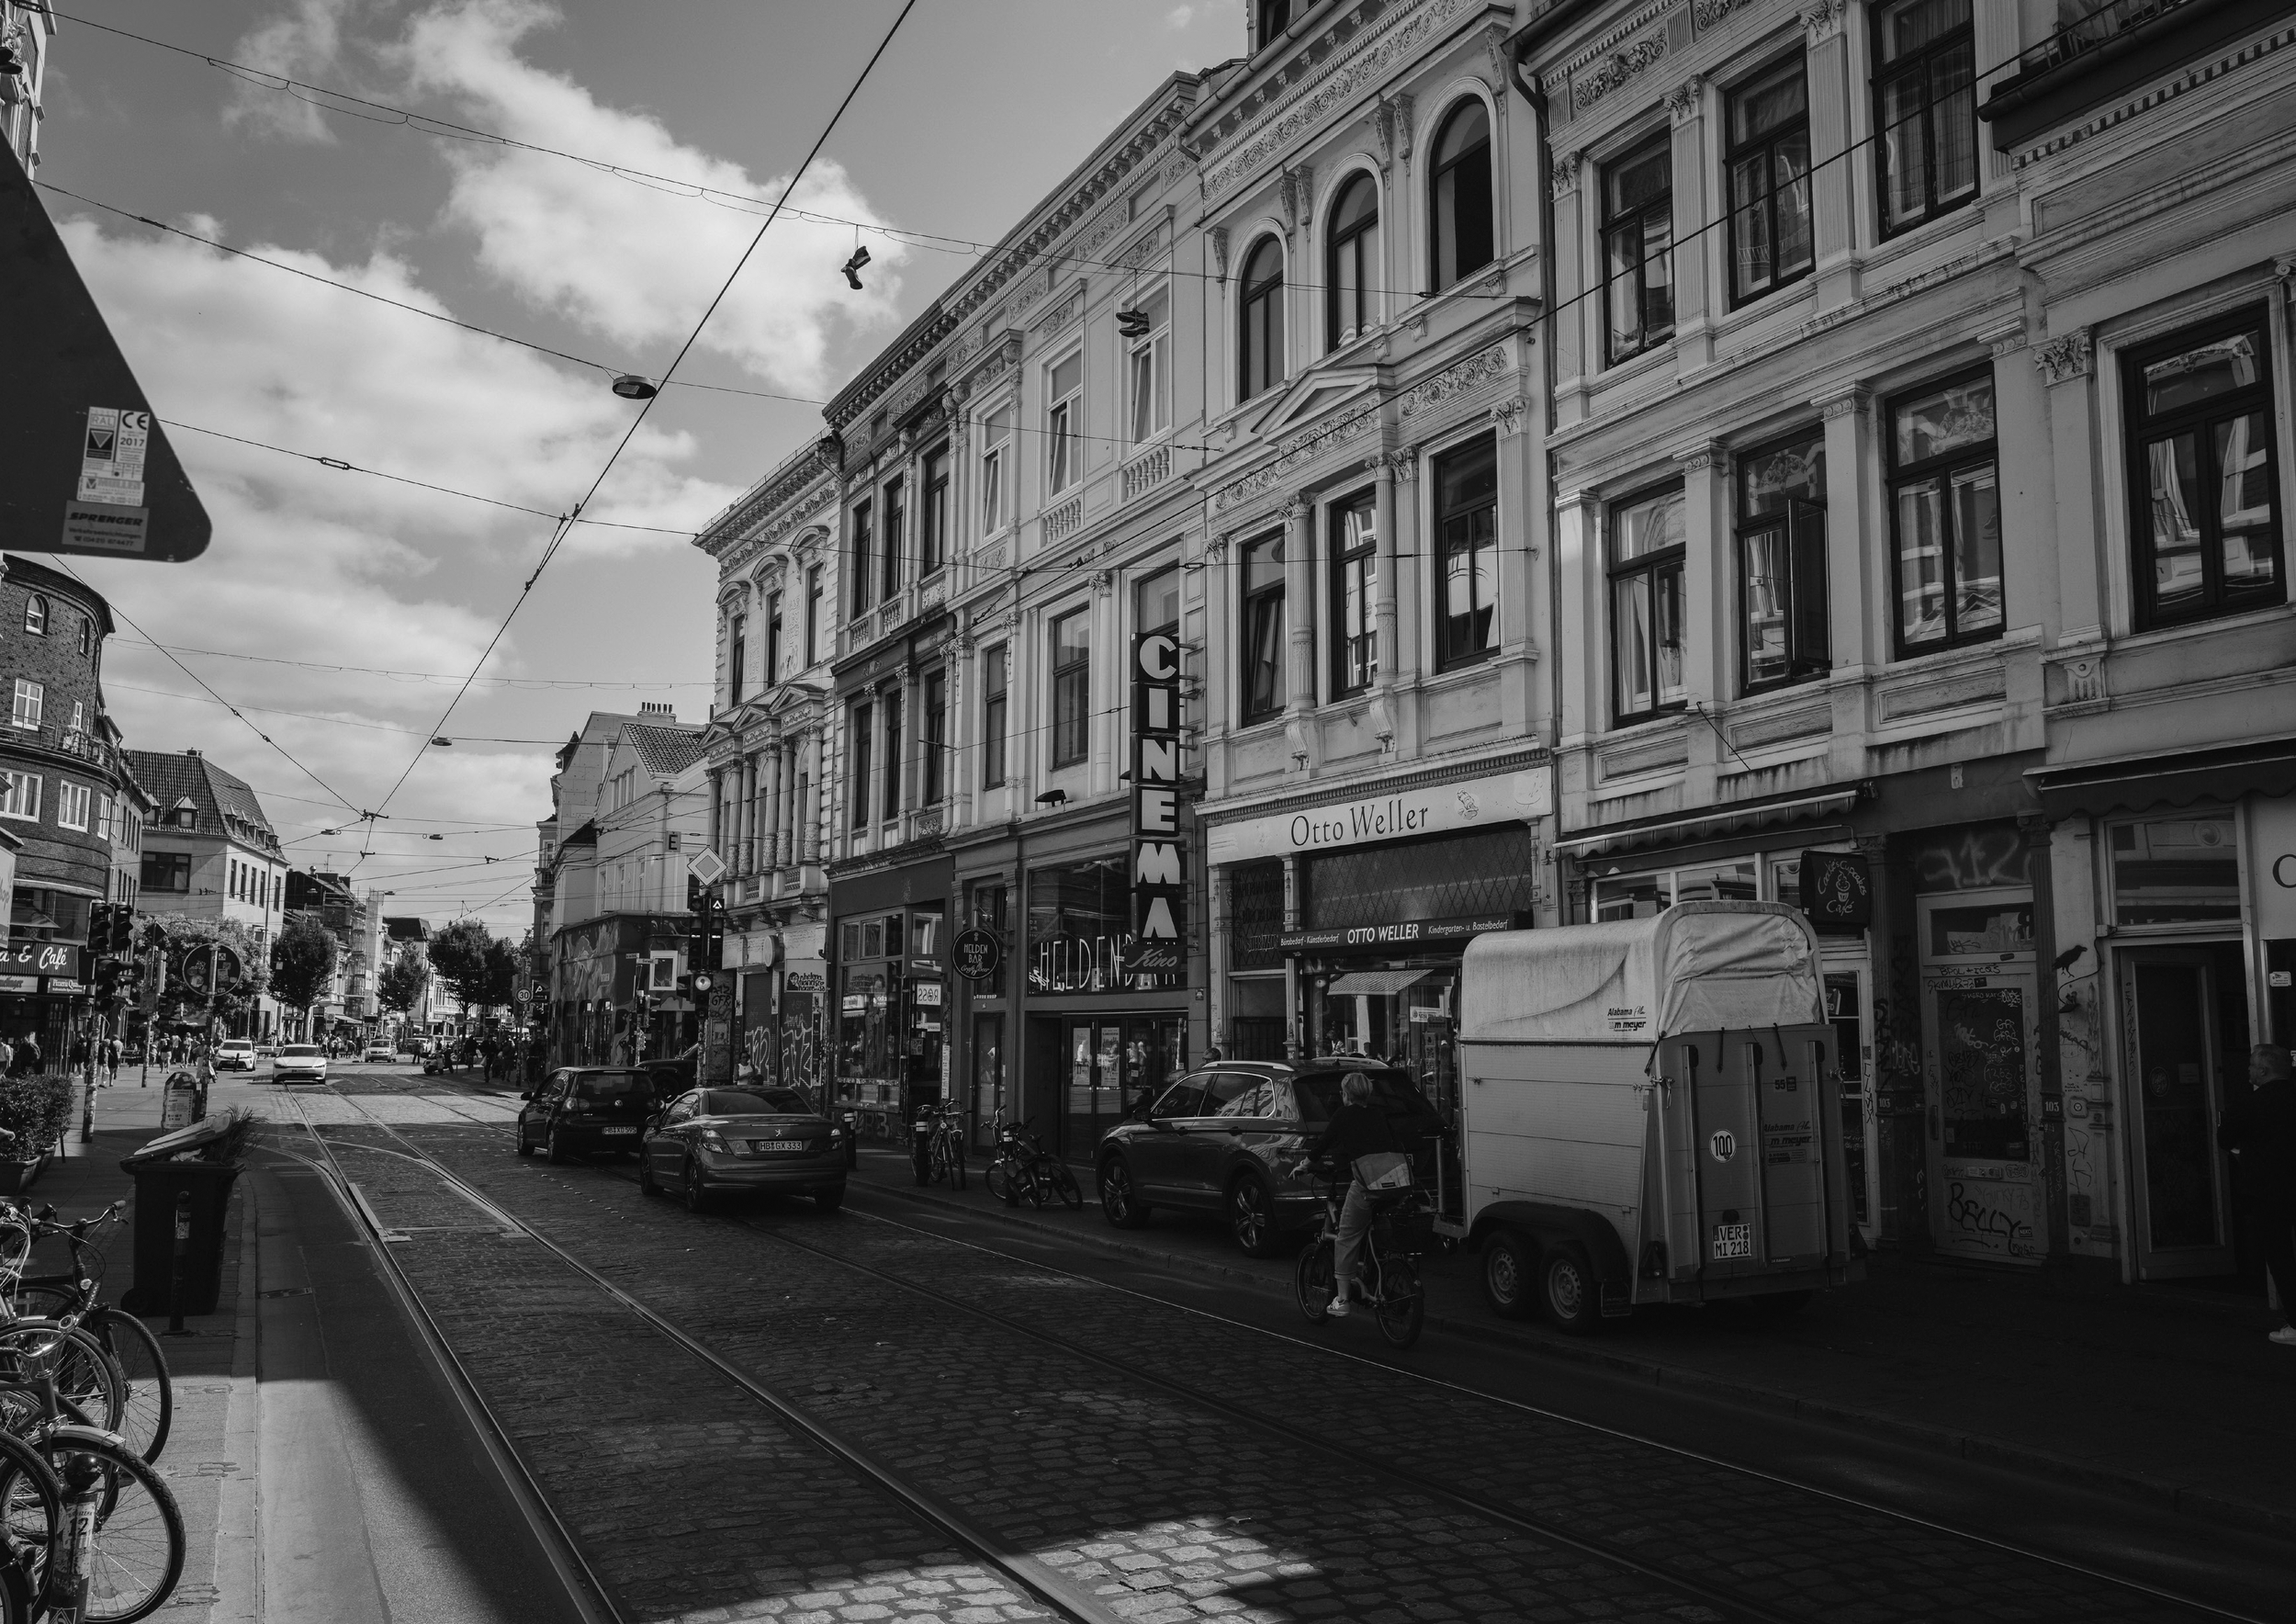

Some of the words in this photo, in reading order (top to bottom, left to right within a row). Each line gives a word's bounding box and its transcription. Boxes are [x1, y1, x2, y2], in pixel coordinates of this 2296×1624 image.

[120, 437, 145, 447] 2017
[69, 512, 143, 526] SPRENGER
[1137, 635, 1181, 939] CINEMA
[1291, 815, 1344, 846] Otto
[1349, 798, 1428, 839] Weller
[1840, 860, 1868, 897] Cupcakes
[1826, 898, 1854, 918] Café
[1280, 935, 1304, 947] Bürobedarf
[1307, 932, 1341, 944] Künstlerbedarf
[1347, 927, 1376, 944] OTTO
[1379, 923, 1420, 942] WELLER
[1428, 924, 1465, 936] Kindergarten-
[1472, 919, 1509, 931] Bastelbedarf
[963, 943, 988, 954] HELDEN
[17, 945, 32, 963] &
[39, 946, 68, 970] Café
[968, 953, 983, 964] BAR
[1125, 948, 1178, 968] Kino
[519, 990, 530, 999] 30
[1607, 1007, 1633, 1017] Alabama
[1623, 1021, 1647, 1032] meyer
[1774, 1078, 1785, 1090] 55
[1878, 1098, 1891, 1109] 103
[2044, 1101, 2060, 1112] 103
[1763, 1122, 1795, 1133] Alabama
[760, 1141, 771, 1151] HB
[775, 1141, 787, 1151] GX
[787, 1140, 802, 1150] 333
[1713, 1134, 1733, 1156] 100
[1782, 1135, 1812, 1147] meyer
[1719, 1225, 1742, 1241] VER
[1715, 1243, 1728, 1257] MI
[1730, 1240, 1750, 1256] 218
